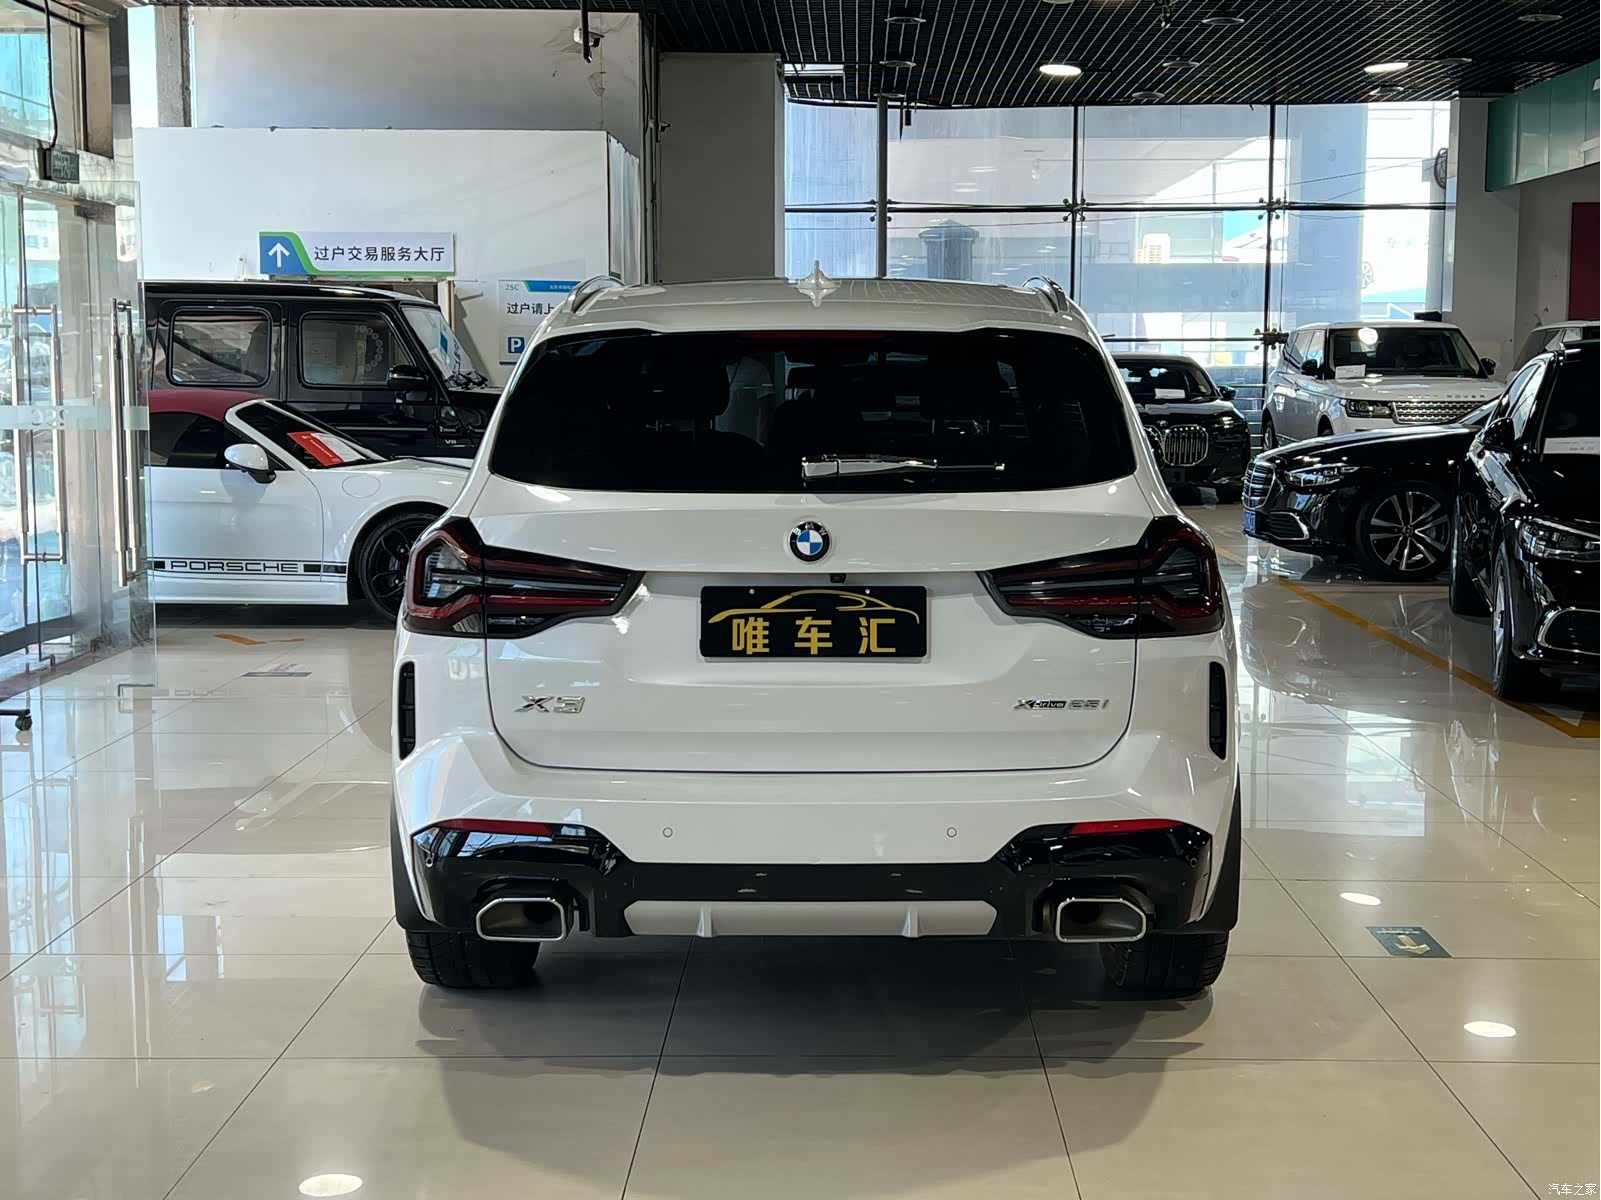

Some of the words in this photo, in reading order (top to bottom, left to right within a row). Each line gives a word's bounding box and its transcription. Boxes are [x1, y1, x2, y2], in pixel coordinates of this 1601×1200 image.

[314, 246, 445, 261] 过户交易服务大厅
[511, 339, 521, 353] P
[170, 560, 299, 573] PORSCHE
[732, 616, 896, 655] 唯车汇
[514, 695, 585, 713] X3
